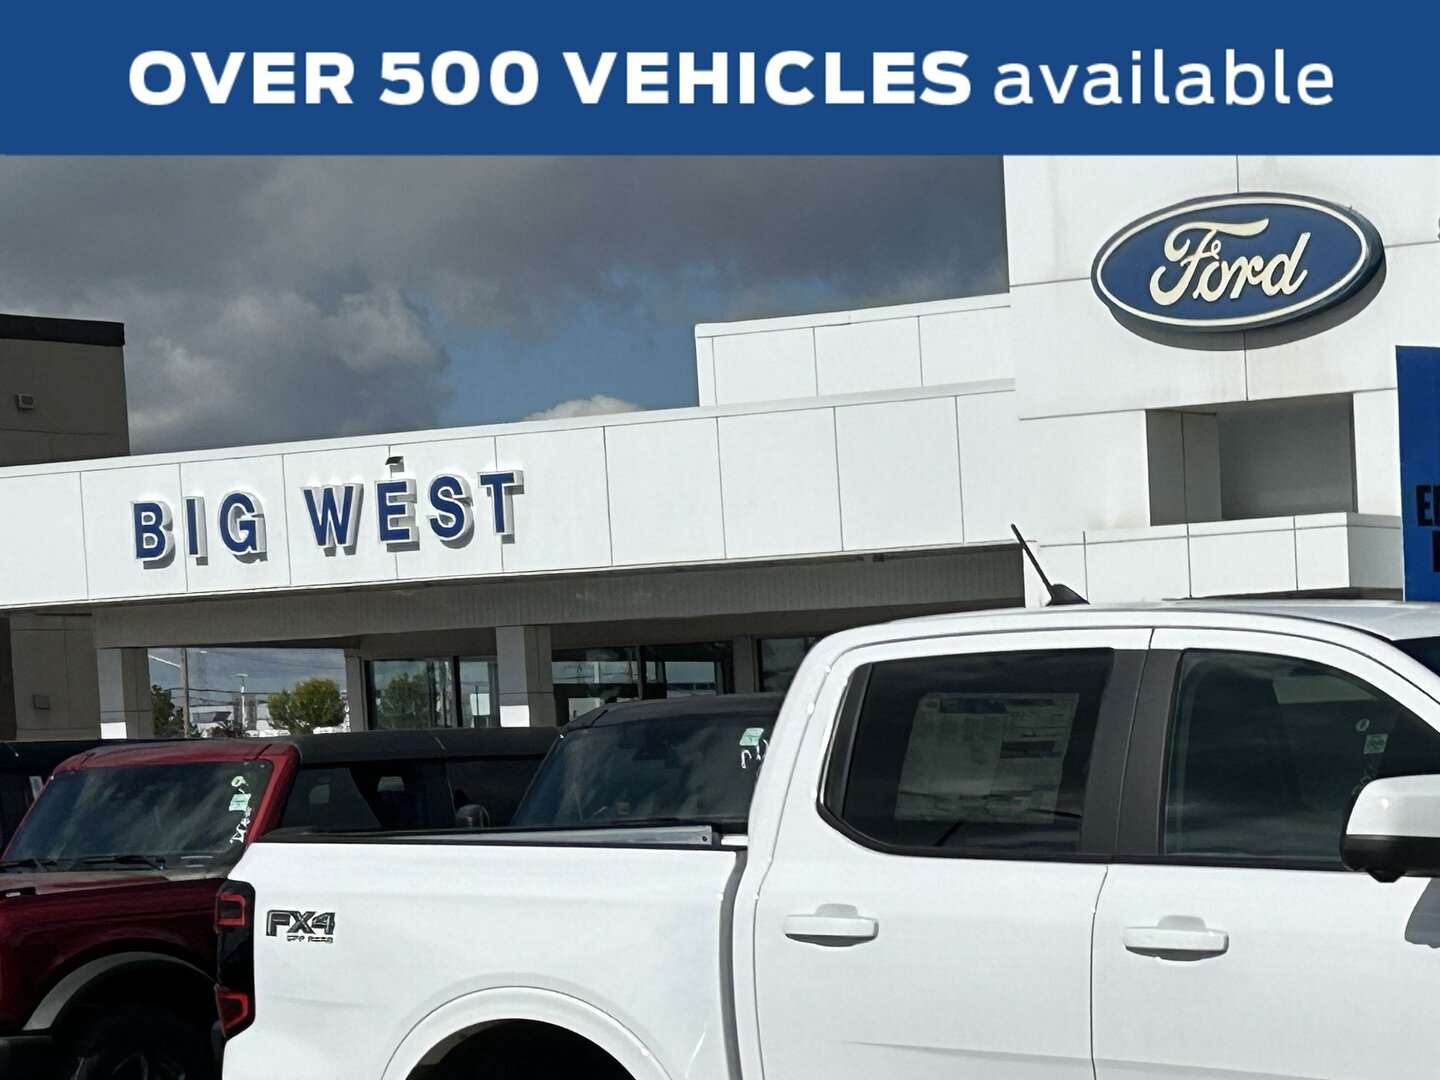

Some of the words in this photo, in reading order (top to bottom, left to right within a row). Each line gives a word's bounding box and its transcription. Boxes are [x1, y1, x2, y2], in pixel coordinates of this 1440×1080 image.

[1150, 218, 1311, 306] Ford
[132, 491, 264, 561] BIG
[303, 471, 520, 547] WEST
[266, 909, 336, 937] FX4
